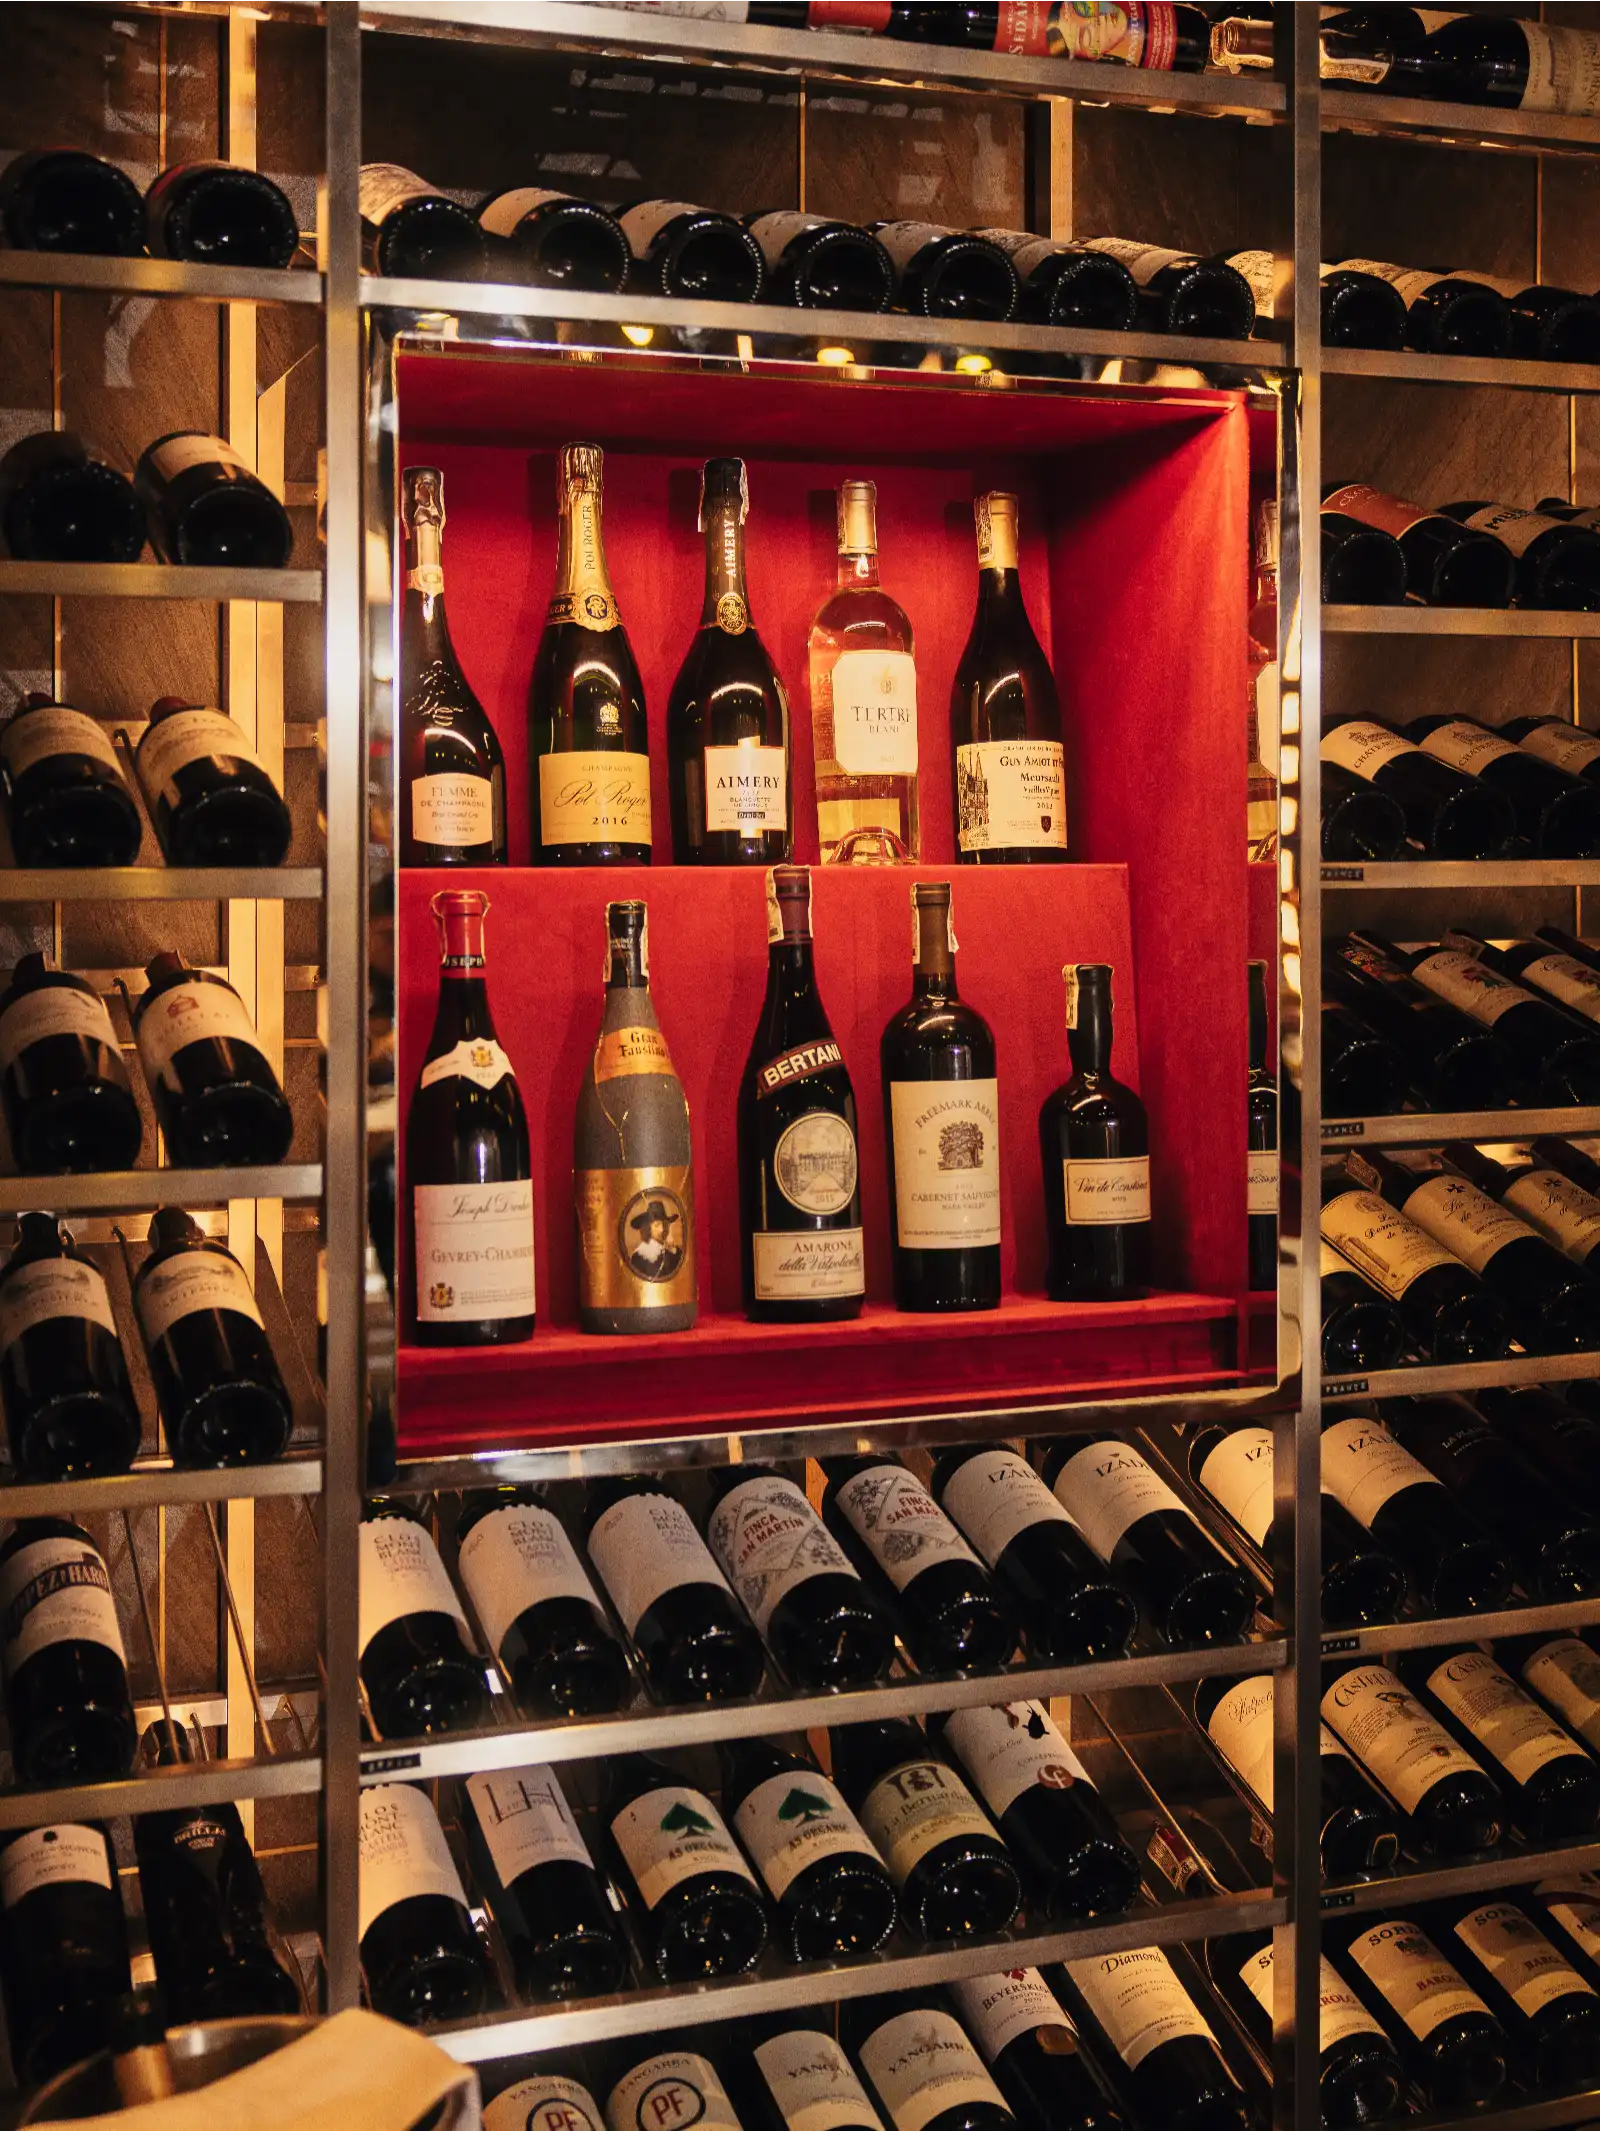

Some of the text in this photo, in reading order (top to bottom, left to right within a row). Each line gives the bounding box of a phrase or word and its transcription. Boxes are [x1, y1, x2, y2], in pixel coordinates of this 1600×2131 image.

[582, 505, 593, 546] ROGER
[724, 518, 736, 578] AIMERY
[717, 776, 780, 789] AIMERY
[436, 800, 486, 808] CHAMPAGNE
[553, 779, 650, 813] Pol Roger
[592, 816, 628, 826] 2016
[630, 1031, 659, 1046] Gran
[764, 1043, 842, 1086] BERTANI
[915, 1099, 972, 1129] FREEMARK
[911, 1192, 958, 1203] CABERNET
[794, 1240, 853, 1255] AMARONE
[743, 1513, 779, 1539] FINCA
[886, 1508, 913, 1523] SAN
[737, 1516, 804, 1568] SAN MARTÍN
[1101, 1952, 1161, 1974] Diamond
[651, 2088, 684, 2126] PF
